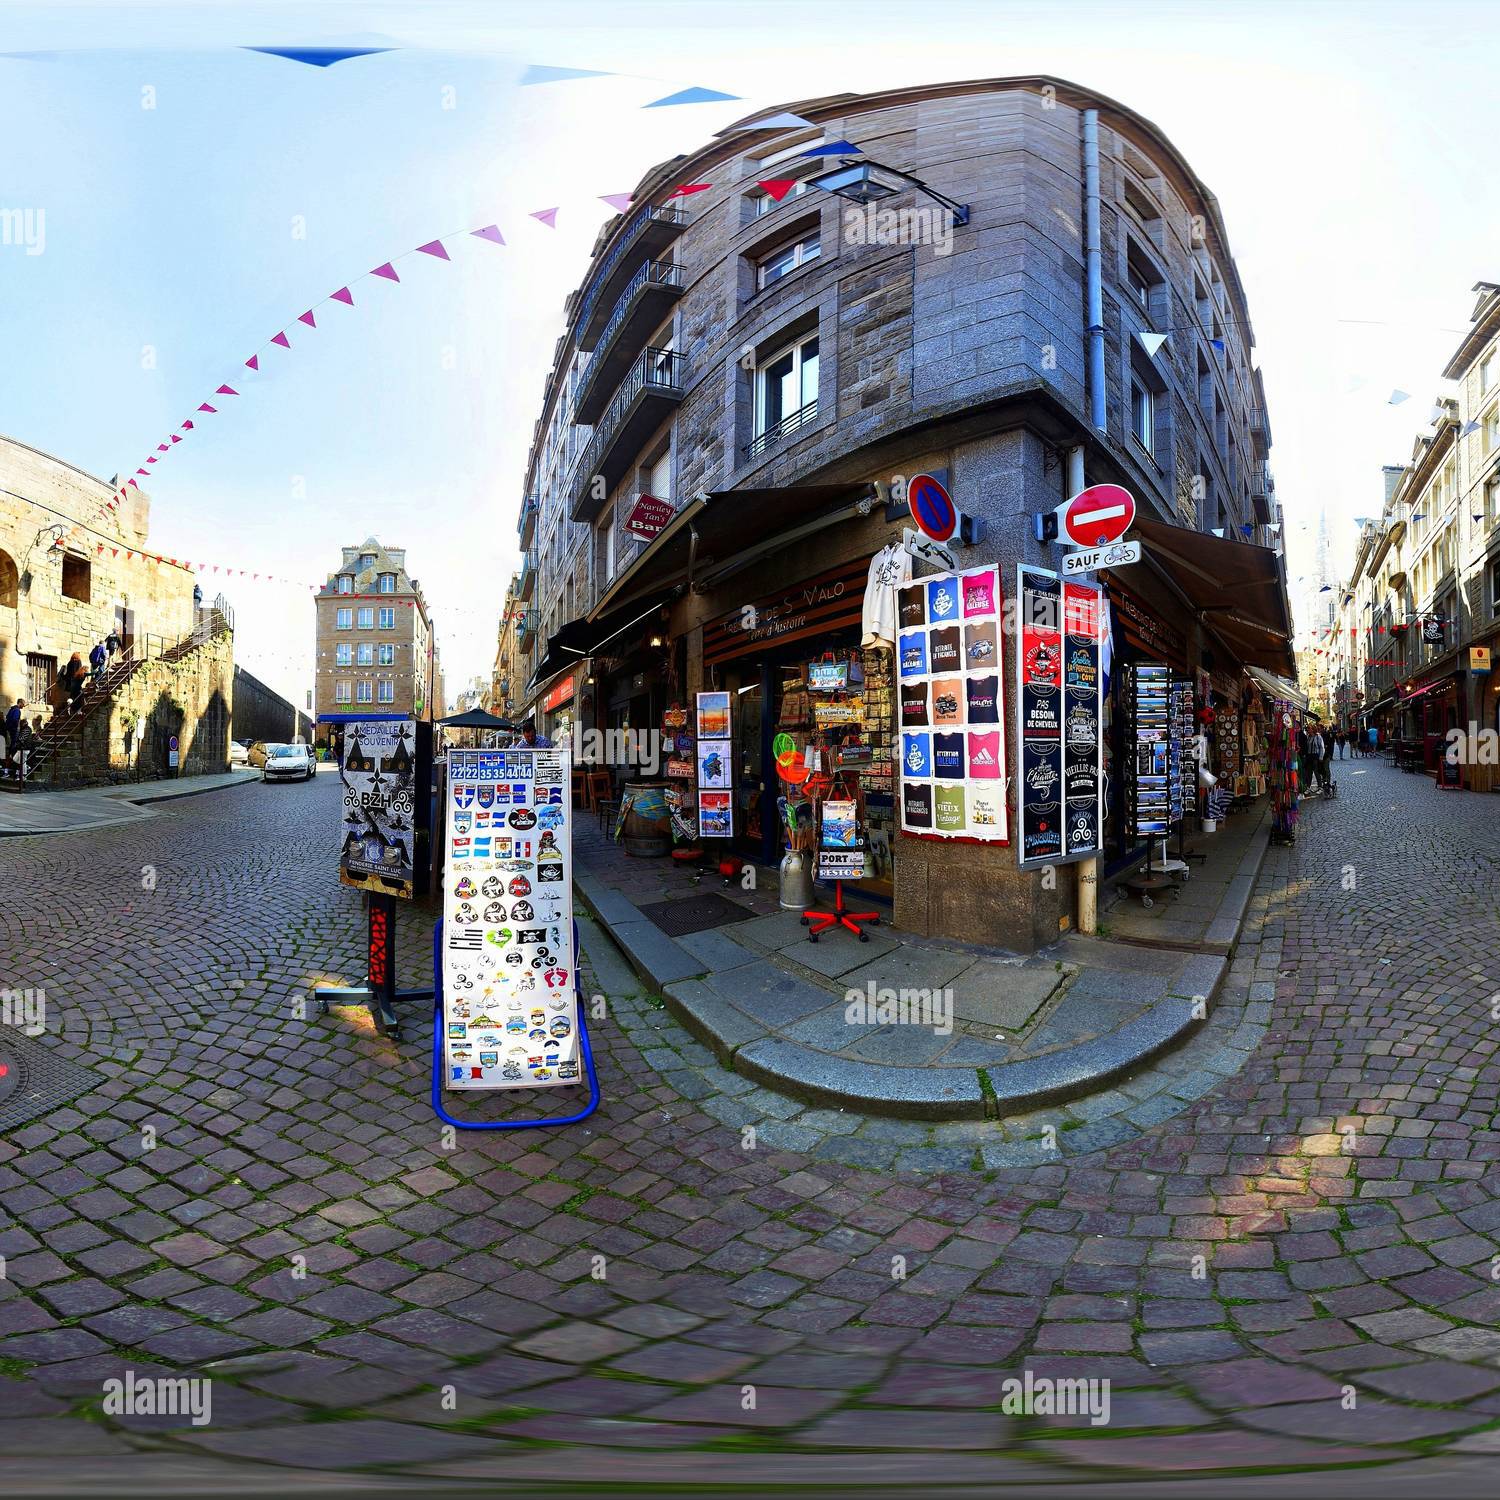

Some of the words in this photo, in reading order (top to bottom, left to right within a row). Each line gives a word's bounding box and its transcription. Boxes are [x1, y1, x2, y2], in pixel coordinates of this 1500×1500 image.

[640, 503, 671, 515] Nariley
[644, 512, 665, 522] Tan's
[631, 520, 663, 532] Bar
[1067, 553, 1100, 570] SAUF
[1036, 699, 1050, 709] PAS
[1030, 709, 1055, 719] BESOIN
[1027, 720, 1034, 728] DE
[1034, 720, 1058, 729] CHEVEUX
[360, 737, 400, 746] SOUVENIR
[451, 768, 464, 778] 22
[466, 768, 478, 778] 22
[480, 769, 493, 779] 35
[493, 769, 505, 779] 35
[507, 768, 518, 778] 44
[520, 768, 532, 778] 44
[361, 792, 392, 808] BZH
[937, 804, 960, 812] VIEUX
[821, 855, 848, 863] PORT
[820, 869, 852, 877] RESTO
